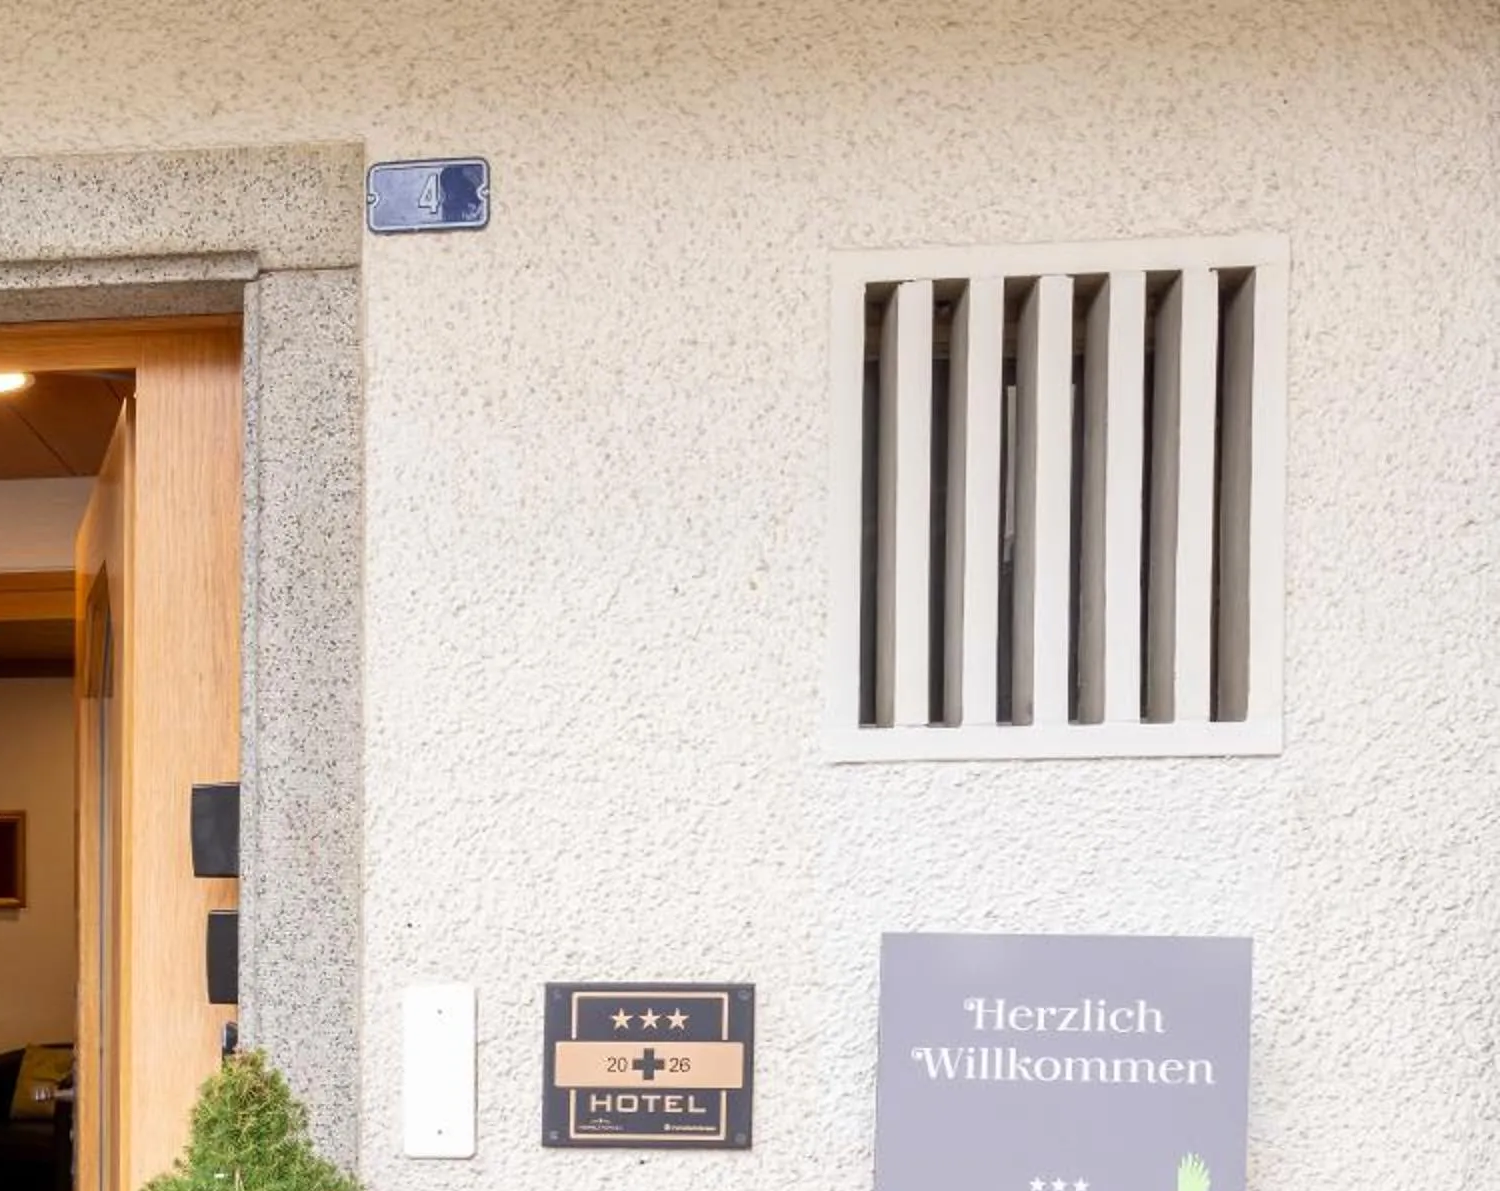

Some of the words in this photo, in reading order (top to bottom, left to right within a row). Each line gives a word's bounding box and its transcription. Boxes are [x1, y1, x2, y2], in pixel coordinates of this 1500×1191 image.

[418, 173, 439, 214] 4
[963, 997, 1165, 1034] Herzlich
[606, 1056, 629, 1073] 20
[668, 1056, 692, 1073] 26
[911, 1046, 1216, 1085] Willkommen
[589, 1093, 707, 1113] HOTEL
